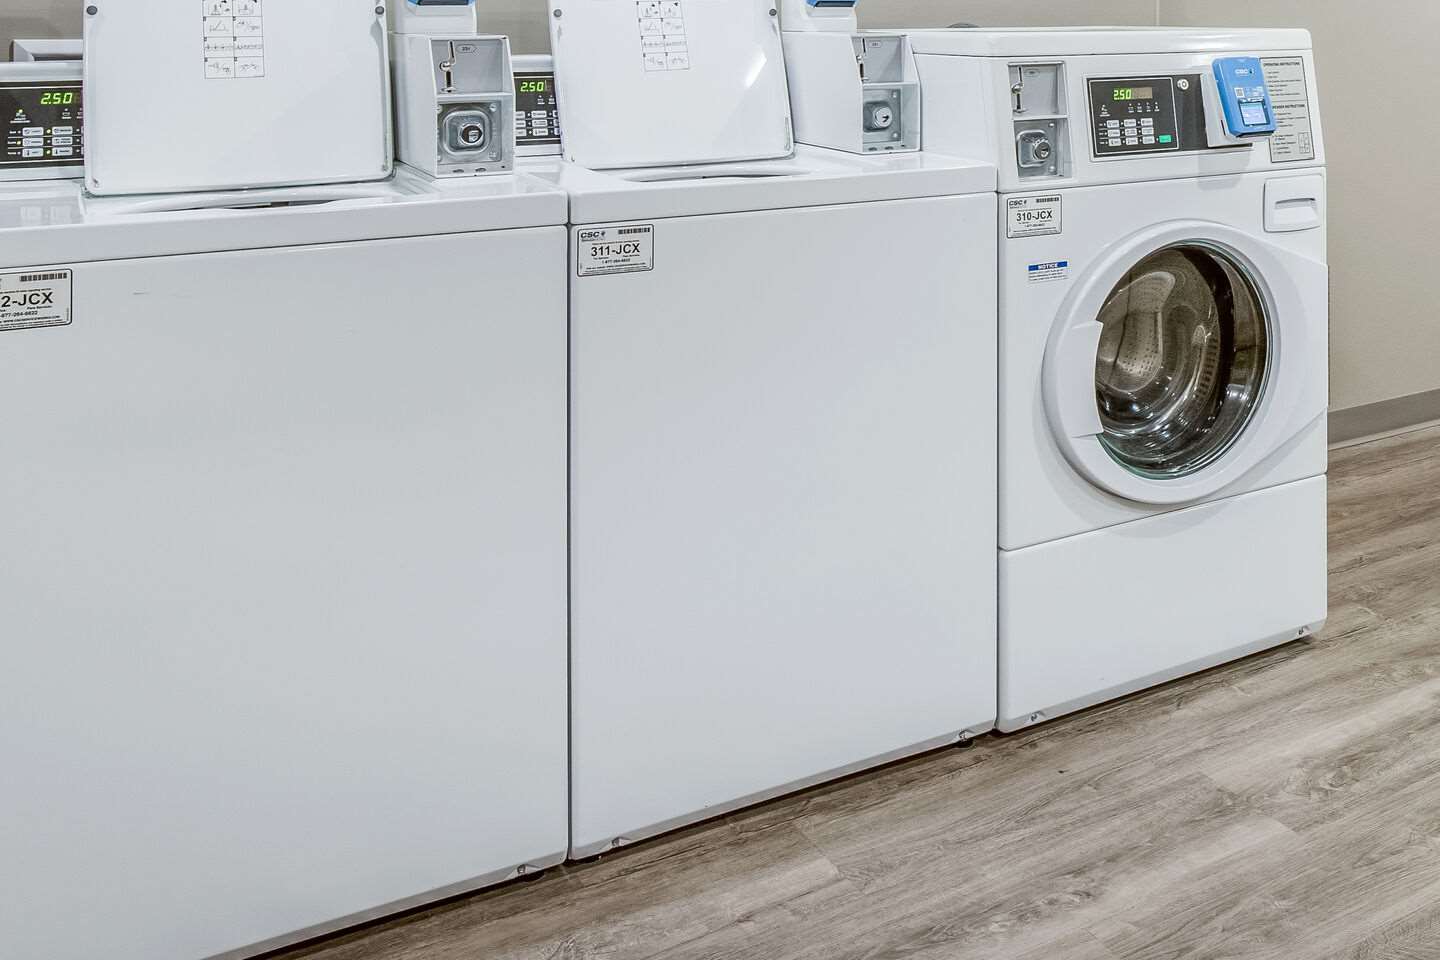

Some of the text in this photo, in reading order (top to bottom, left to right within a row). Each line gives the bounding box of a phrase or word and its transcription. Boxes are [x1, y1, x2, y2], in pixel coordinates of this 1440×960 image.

[40, 92, 73, 105] 2.50
[1016, 210, 1052, 222] 310-JCX
[591, 243, 640, 256] 311-JCX
[1, 291, 54, 308] 2-JCX
